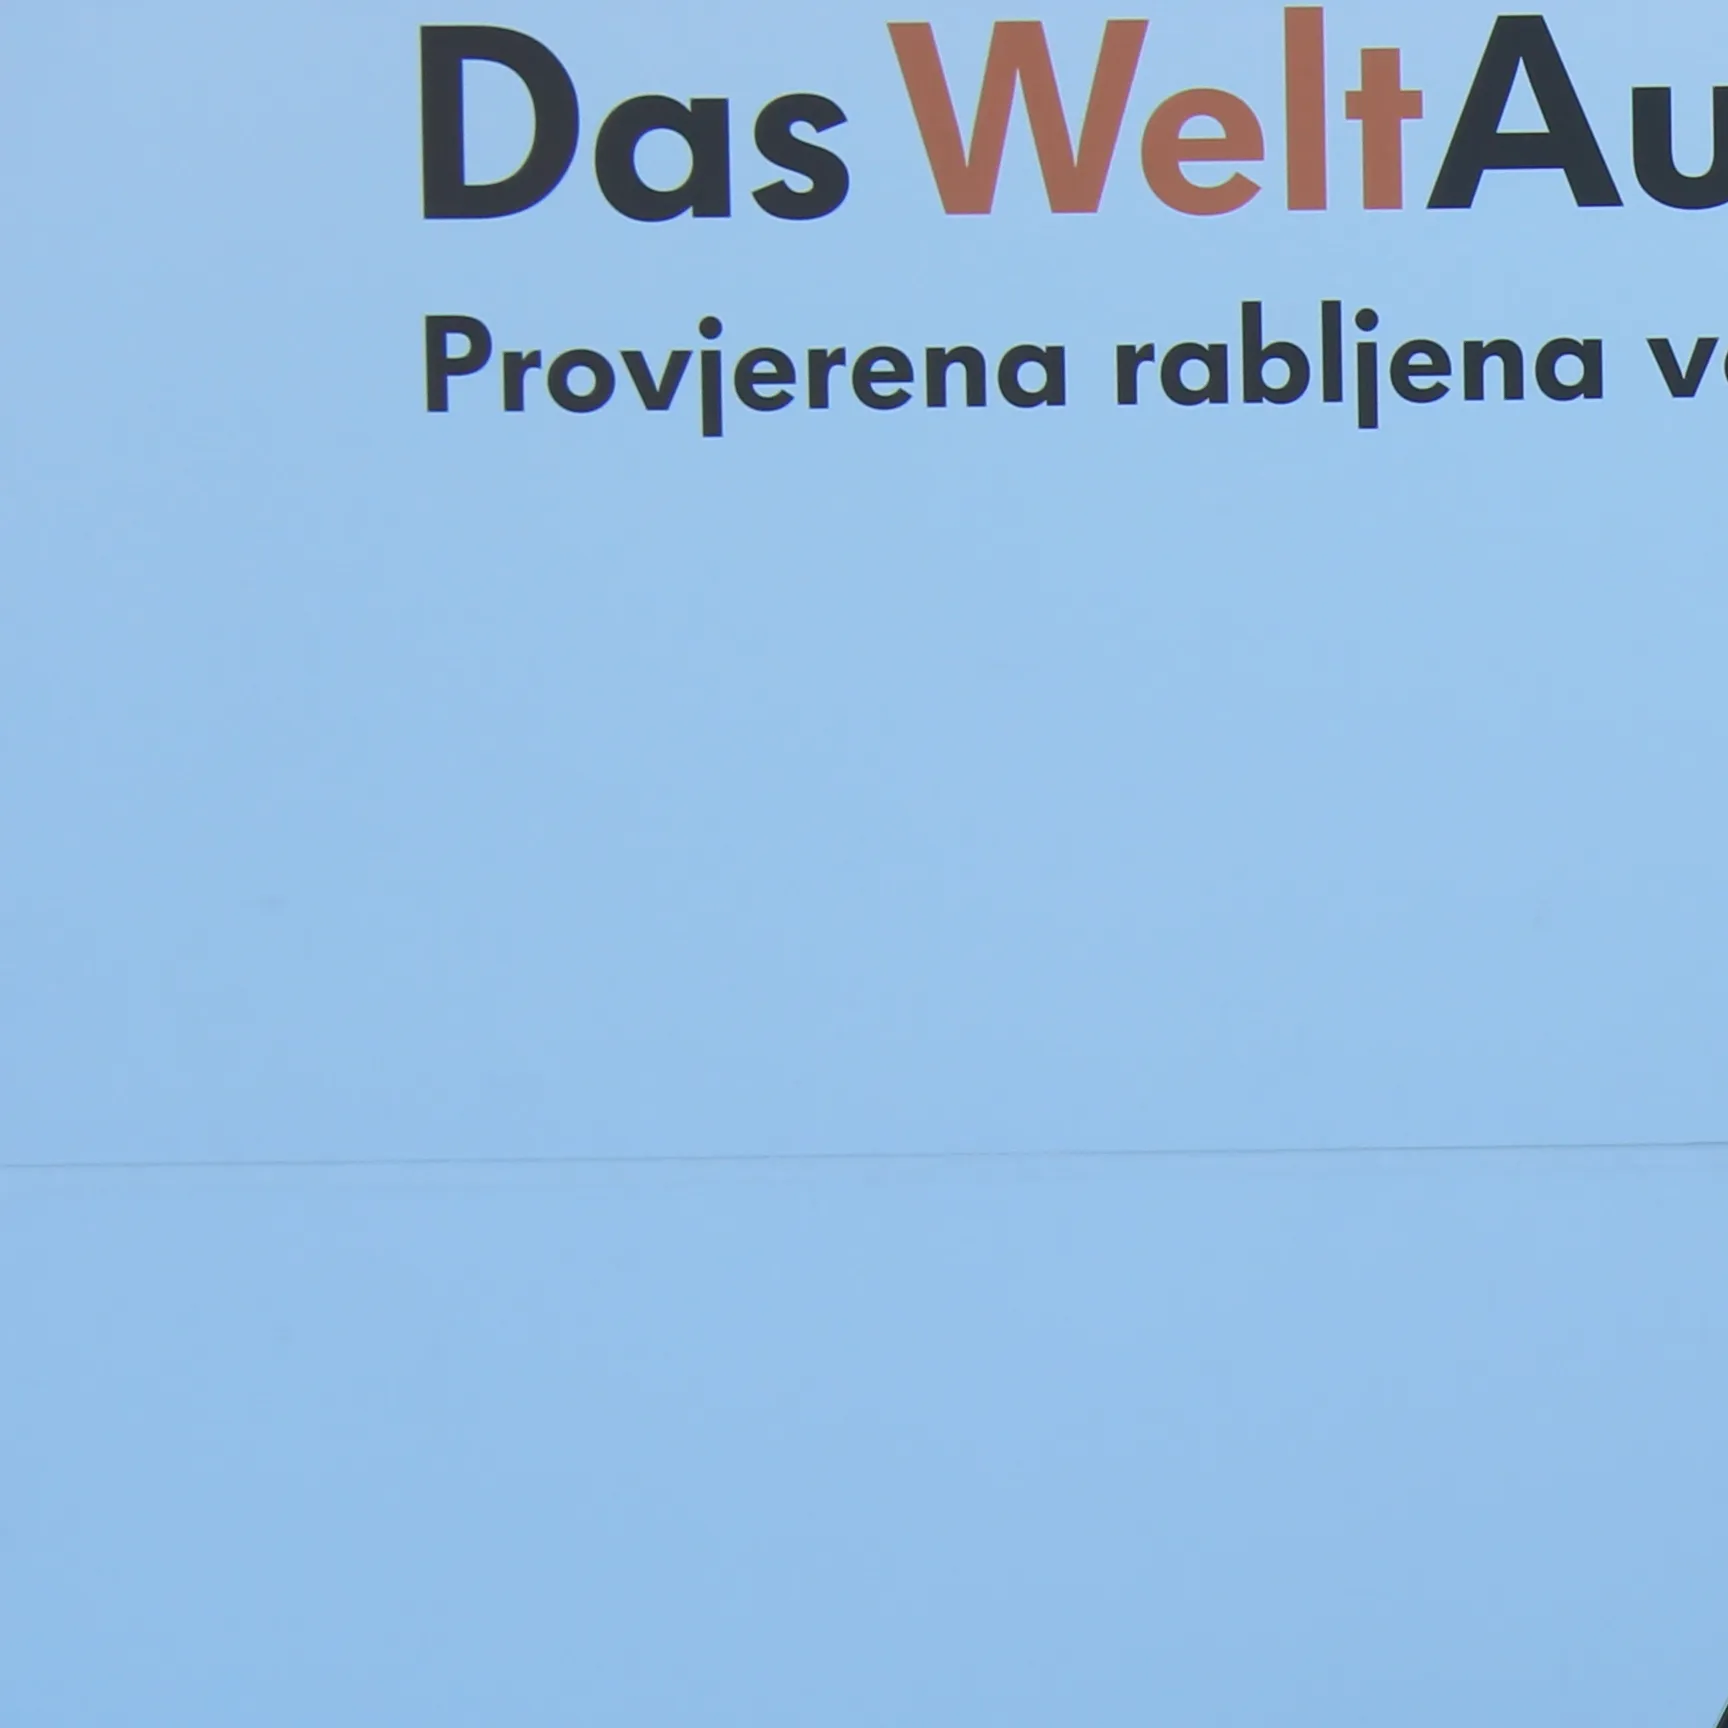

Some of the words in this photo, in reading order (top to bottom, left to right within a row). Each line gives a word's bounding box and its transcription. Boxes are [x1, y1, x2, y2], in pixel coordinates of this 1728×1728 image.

[420, 24, 850, 223] Das
[423, 314, 1067, 438] Provjerena
[1115, 299, 1604, 430] rabljena
